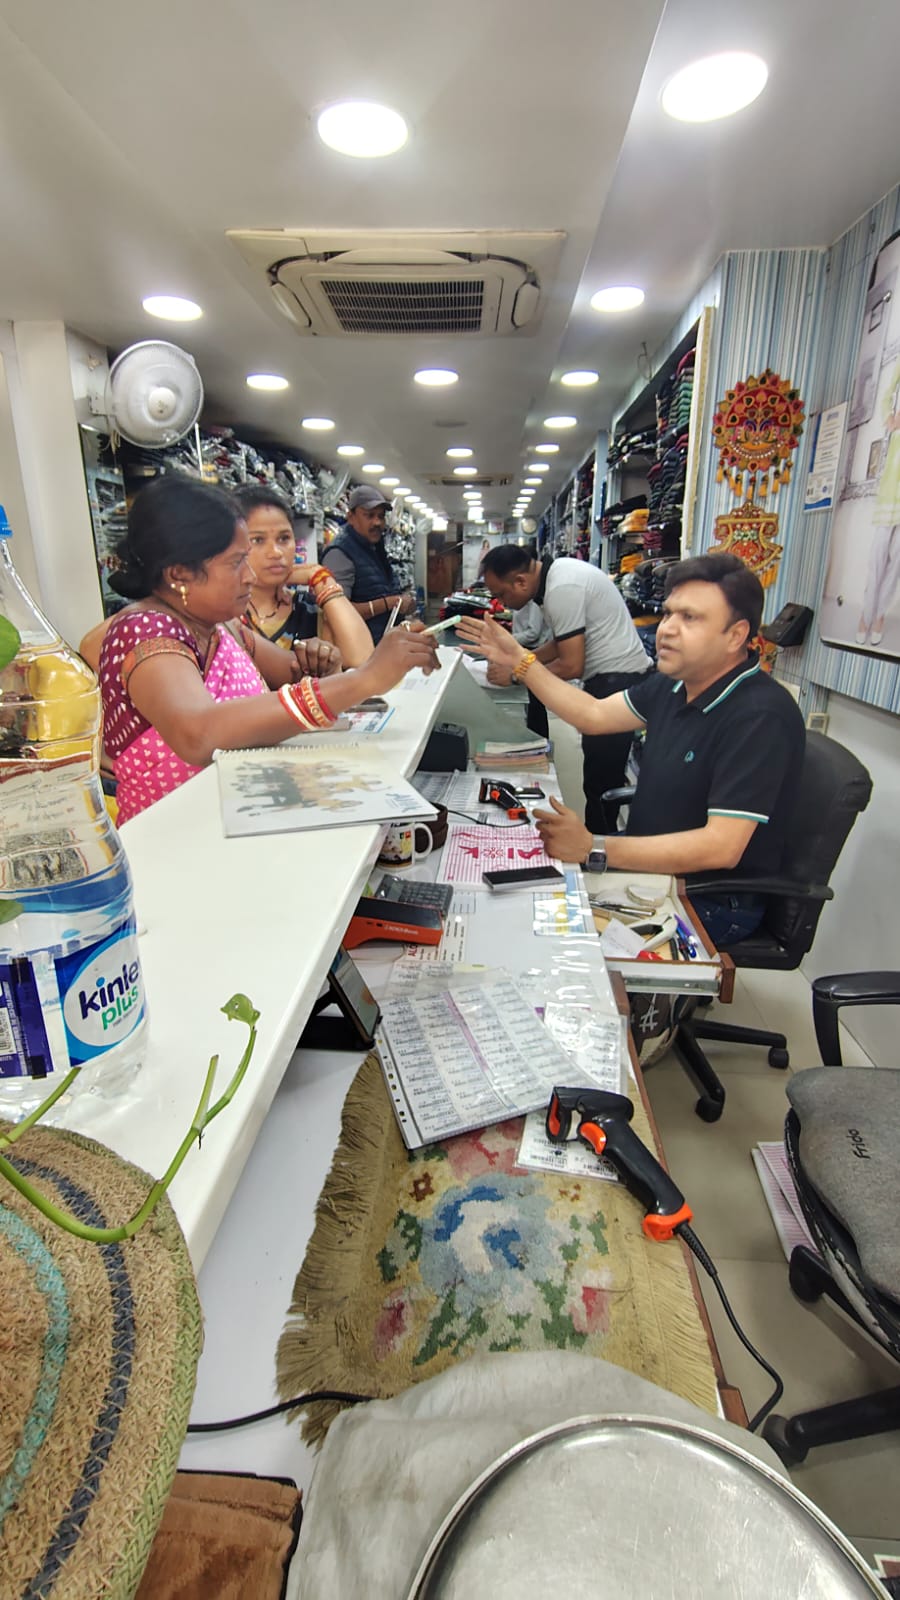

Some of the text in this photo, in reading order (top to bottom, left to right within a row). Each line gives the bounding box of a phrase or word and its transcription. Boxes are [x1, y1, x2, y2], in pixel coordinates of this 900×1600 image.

[79, 959, 140, 1019] kinle
[101, 985, 139, 1030] plus
[845, 1128, 871, 1159] frido
